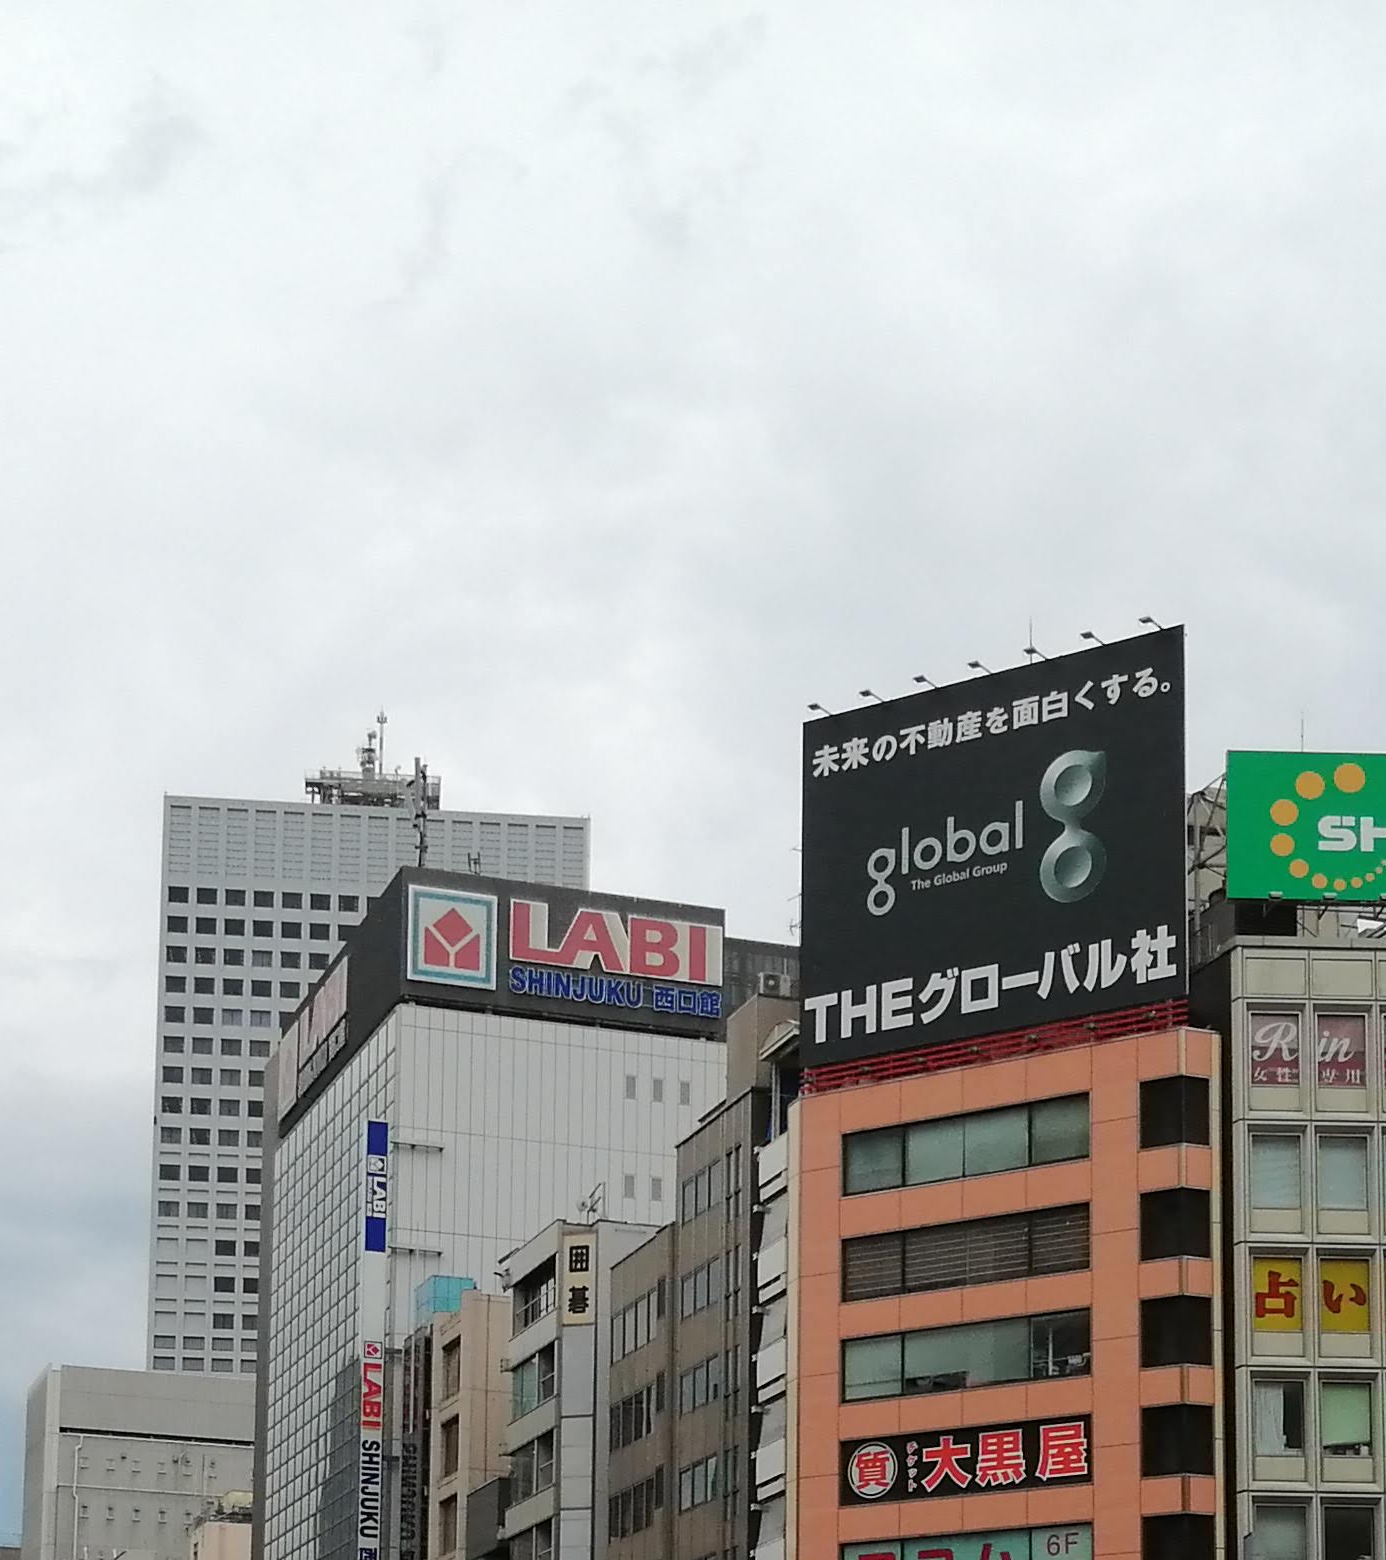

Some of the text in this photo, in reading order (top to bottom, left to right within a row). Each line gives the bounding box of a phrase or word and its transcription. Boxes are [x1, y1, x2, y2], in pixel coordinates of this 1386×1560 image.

[812, 666, 1172, 779] 未来の不動産を面白くする。
[866, 800, 1025, 916] global
[911, 860, 1009, 892] The Global Group
[509, 898, 724, 988] LABI
[509, 966, 723, 1020] SHINJUKU 西口館
[805, 925, 1178, 1046] THEグローバル社
[372, 1176, 387, 1218] LABI
[361, 1360, 383, 1430] LABI
[359, 1438, 382, 1539] SHINJUKU
[854, 1449, 893, 1491] 質
[921, 1420, 1090, 1494] 大黒屋
[1045, 1532, 1080, 1557] 6F
